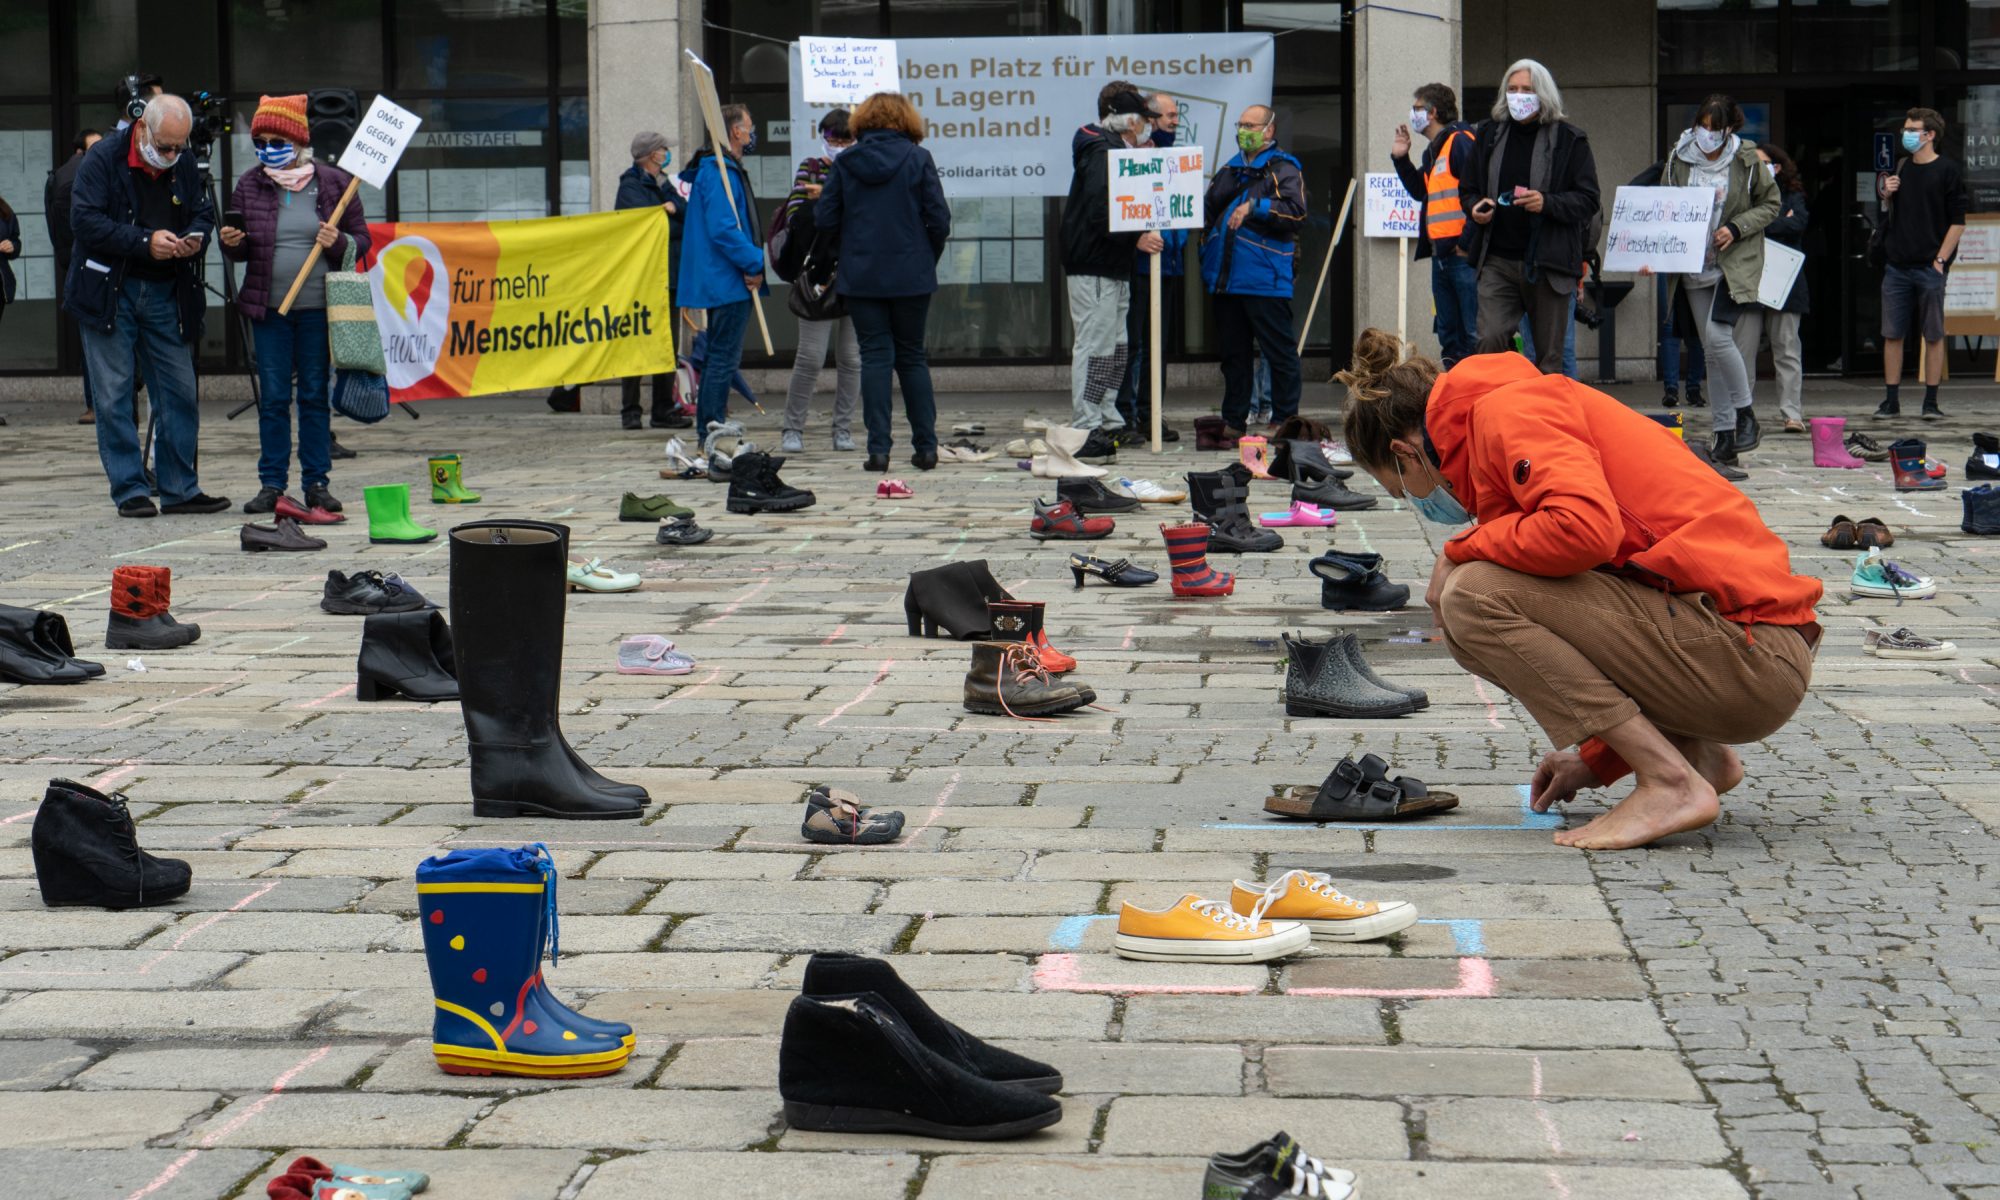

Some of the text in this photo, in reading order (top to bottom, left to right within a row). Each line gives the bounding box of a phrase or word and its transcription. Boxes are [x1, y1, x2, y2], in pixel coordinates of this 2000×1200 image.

[809, 42, 827, 53] Das
[832, 42, 847, 53] sind
[813, 67, 874, 77] Schwestern und
[898, 53, 1253, 79] ben Platz für Menschen
[831, 79, 861, 89] Brüder
[935, 87, 1036, 112] Lagern
[376, 109, 405, 130] OMAS
[924, 116, 1051, 138] henland!
[366, 125, 397, 148] GEGEN
[426, 132, 522, 146] AMTSTAFEL
[355, 140, 389, 165] RECHTS
[937, 162, 1045, 179] Solidarität OÖ
[1119, 157, 1163, 177] HEIMAT
[1179, 154, 1202, 173] ALLE
[1170, 193, 1194, 219] ALLE
[1389, 209, 1420, 221] ALL
[1383, 221, 1419, 231] MENSC
[452, 263, 550, 304] für mehr
[450, 300, 652, 357] Menschlichkeit
